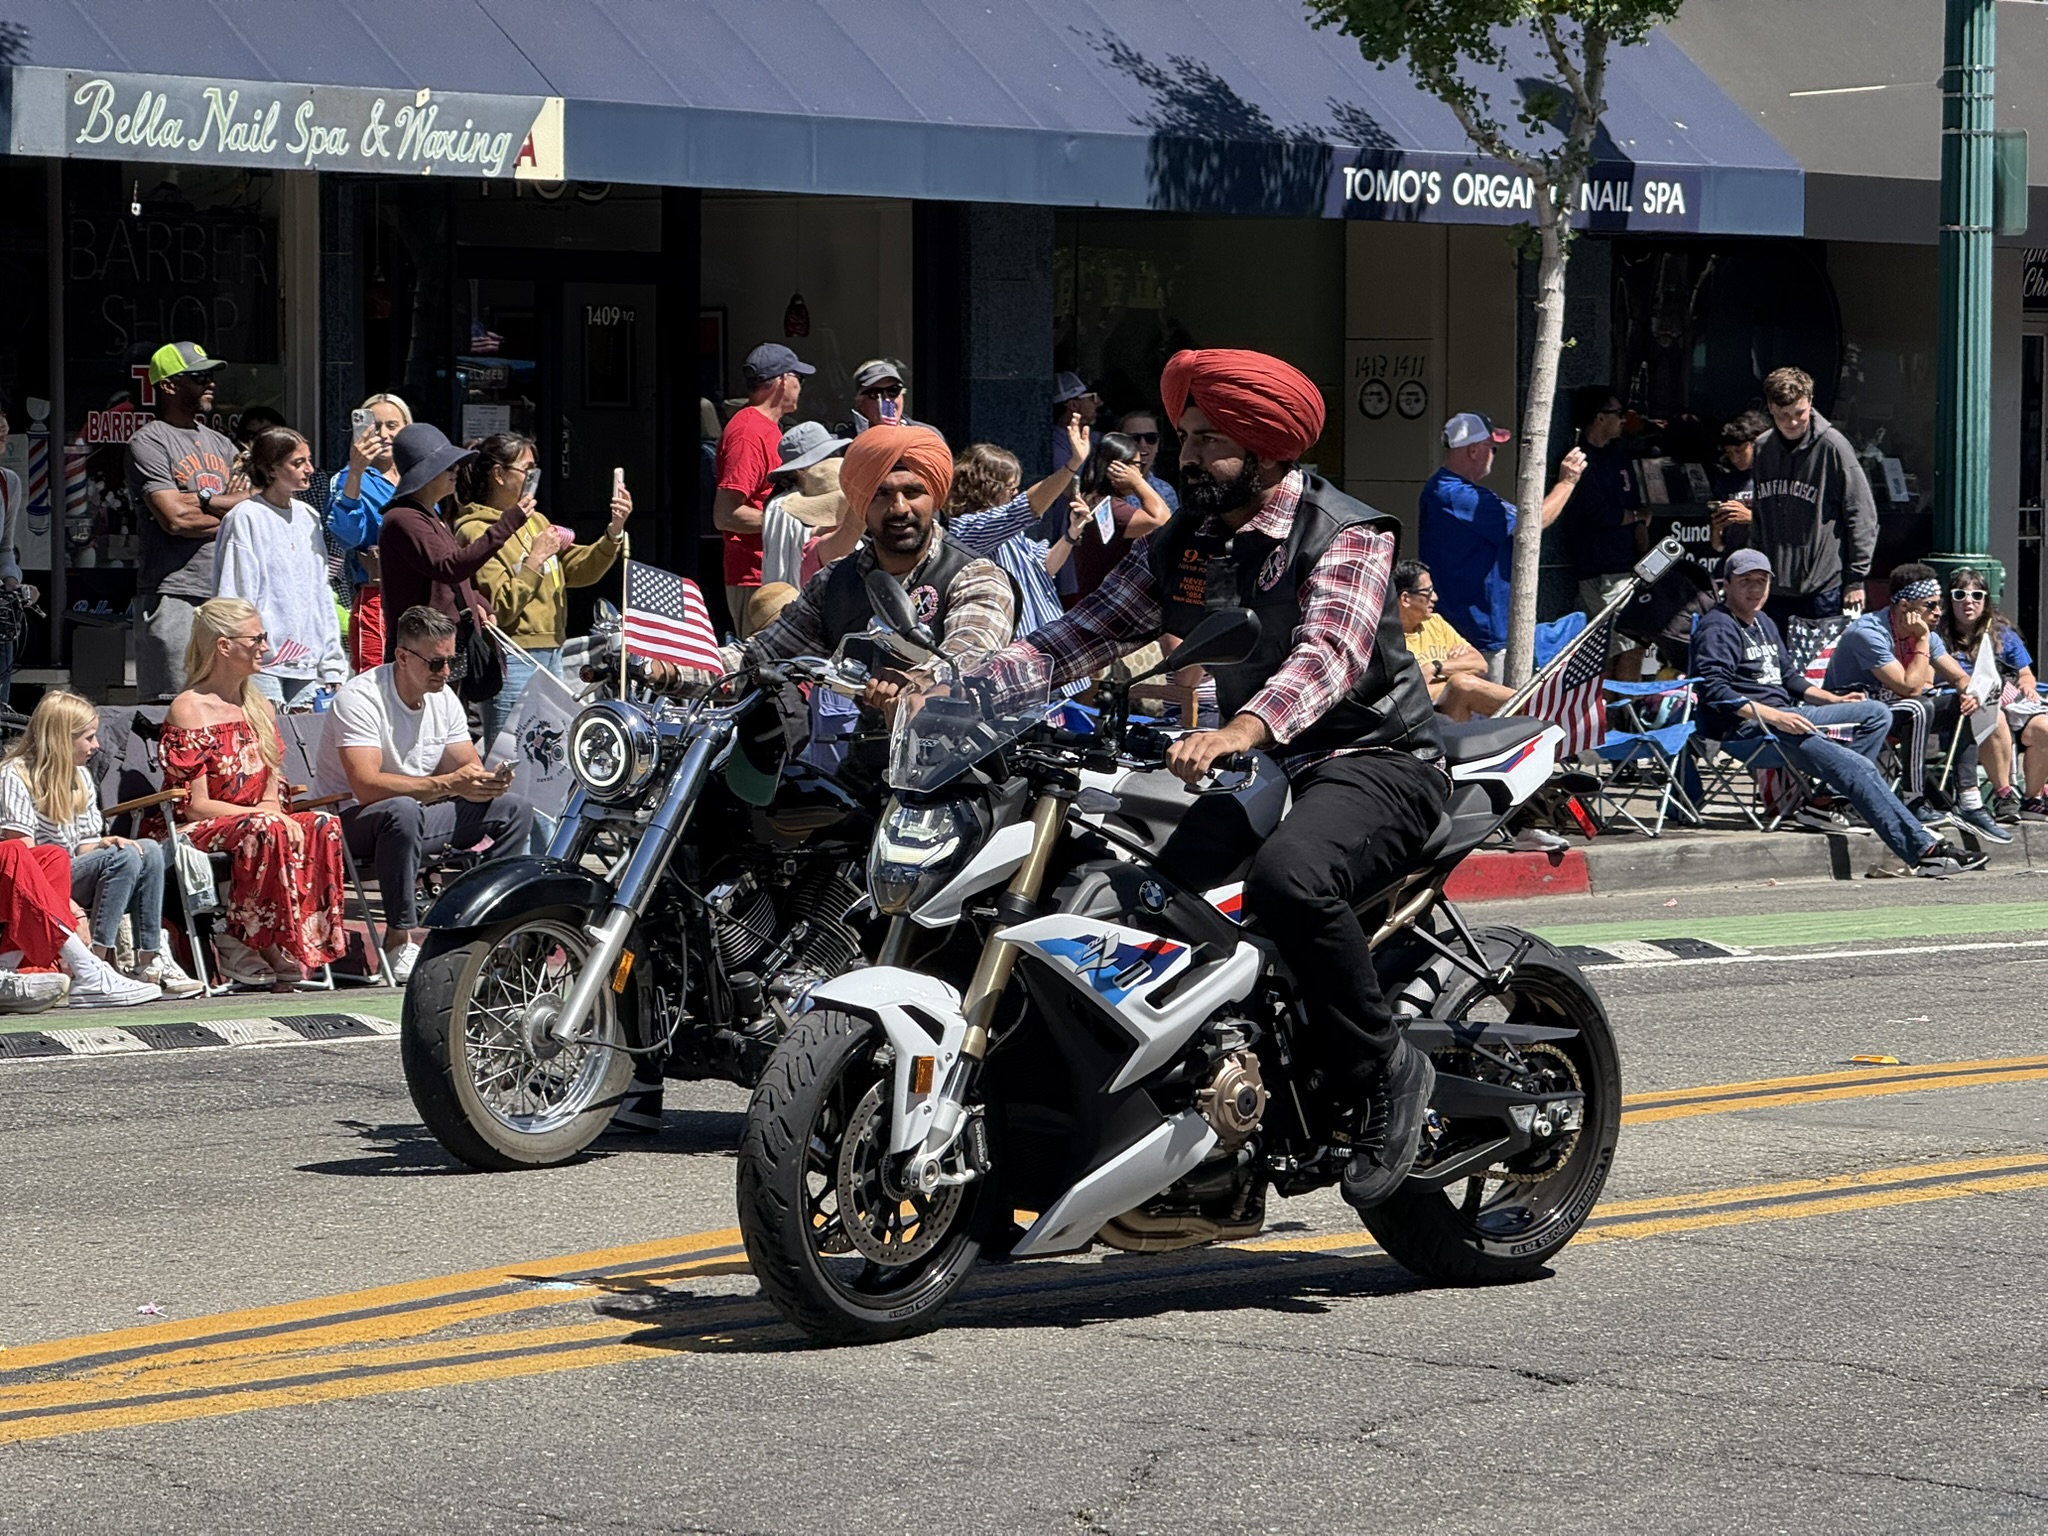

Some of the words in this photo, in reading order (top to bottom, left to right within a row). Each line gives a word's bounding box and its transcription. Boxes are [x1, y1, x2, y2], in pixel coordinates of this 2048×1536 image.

[74, 79, 185, 148] Bella
[187, 87, 281, 153] Nail
[286, 100, 350, 167] Spa
[360, 98, 390, 158] &
[394, 104, 512, 177] Waxing
[1343, 167, 1442, 205] TOMO'S
[1453, 172, 1568, 210] ORGAN
[1581, 180, 1634, 212] NAIL
[1643, 181, 1686, 214] SPA
[70, 218, 268, 285] BARBER
[101, 294, 239, 356] SHOP
[586, 305, 620, 326] 1409
[622, 310, 635, 322] 1/2
[469, 369, 504, 380] CLOSED
[1355, 354, 1388, 377] 1413
[1394, 355, 1425, 377] 1411
[174, 453, 203, 484] NEW
[1757, 481, 1773, 500] SAN
[1671, 521, 1711, 543] Sund
[1179, 582, 1207, 593] FORGE
[975, 1122, 985, 1163] brembo
[1571, 1165, 1604, 1219] MICHELIN
[1513, 1244, 1525, 1255] 17
